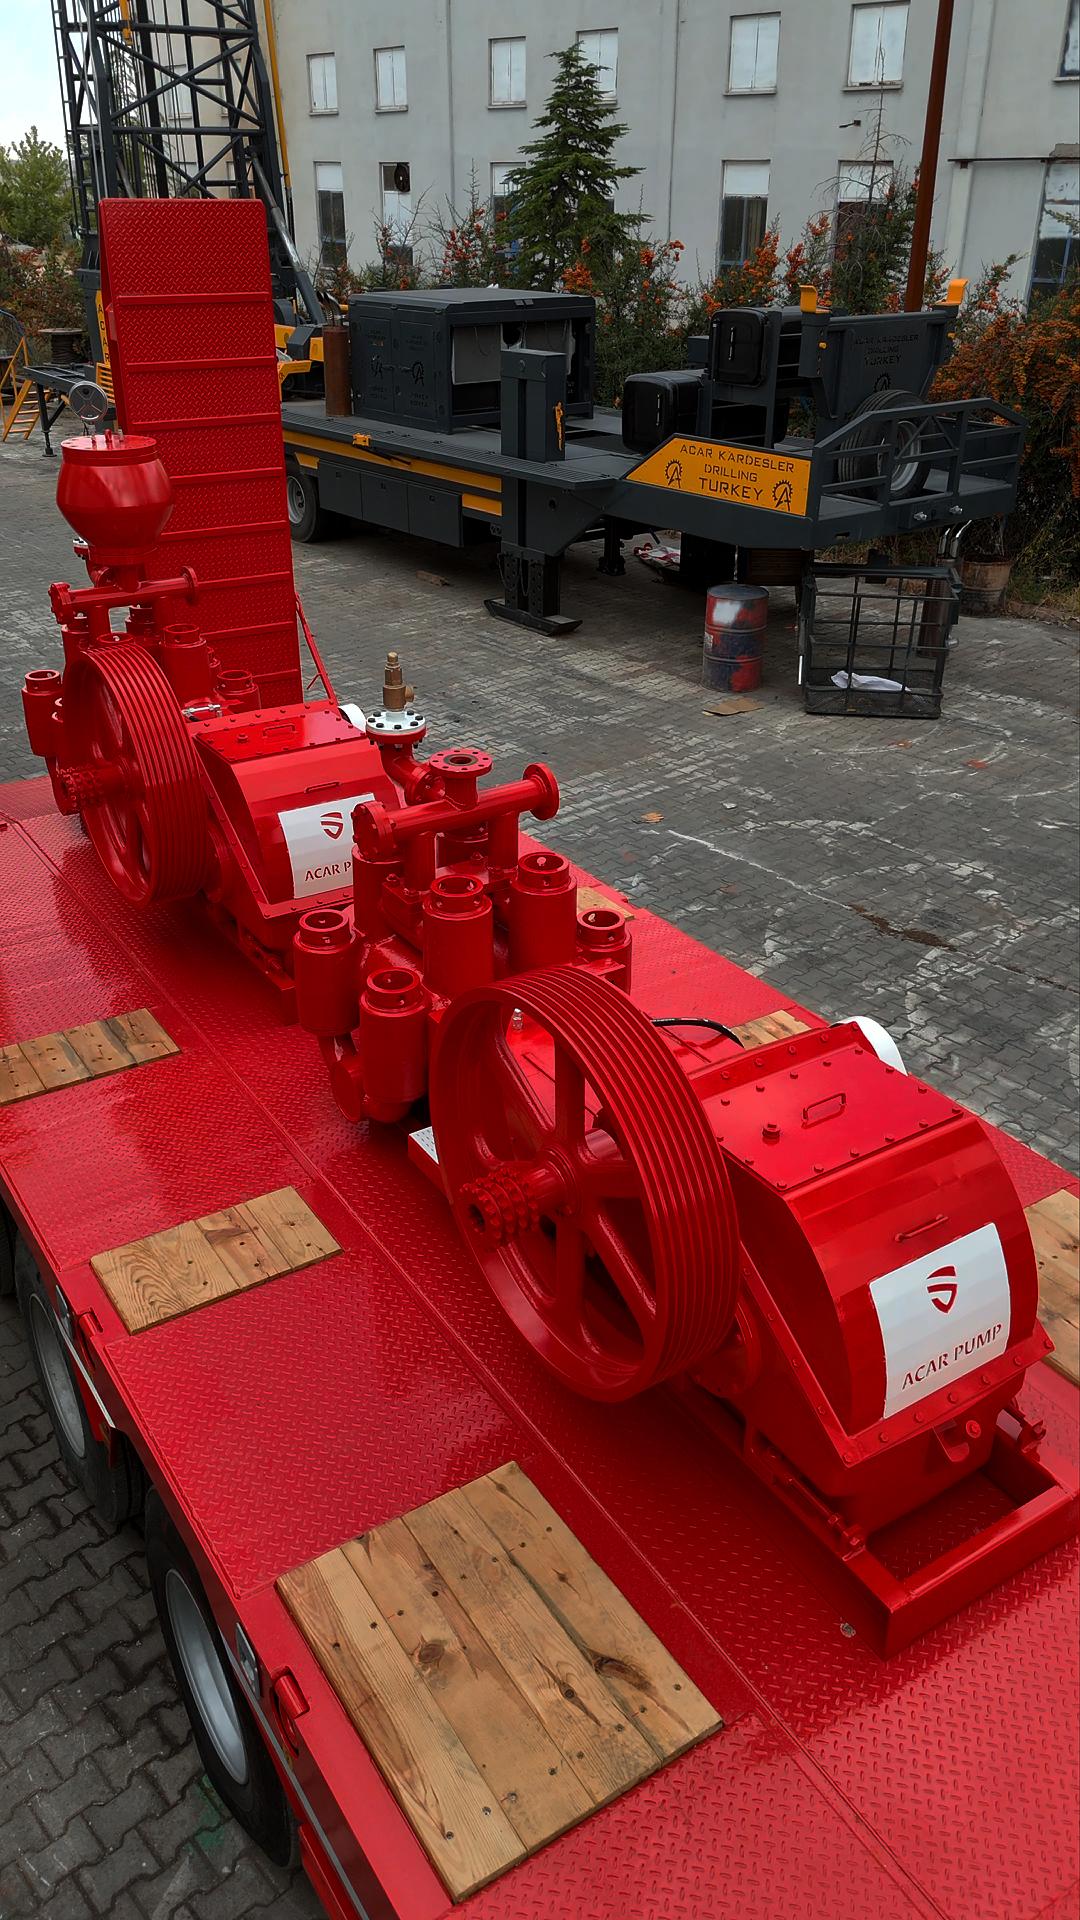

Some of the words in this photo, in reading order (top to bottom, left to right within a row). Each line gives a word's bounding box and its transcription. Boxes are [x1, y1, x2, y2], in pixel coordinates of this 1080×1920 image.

[864, 354, 902, 366] TURKEY
[680, 444, 713, 458] ACAR
[718, 450, 794, 473] KARDESLER
[704, 463, 758, 483] DRILLING
[699, 477, 763, 500] TURKEY
[305, 864, 340, 881] ACAR
[902, 1353, 949, 1390] ACAR
[954, 1323, 1002, 1361] PUMP
